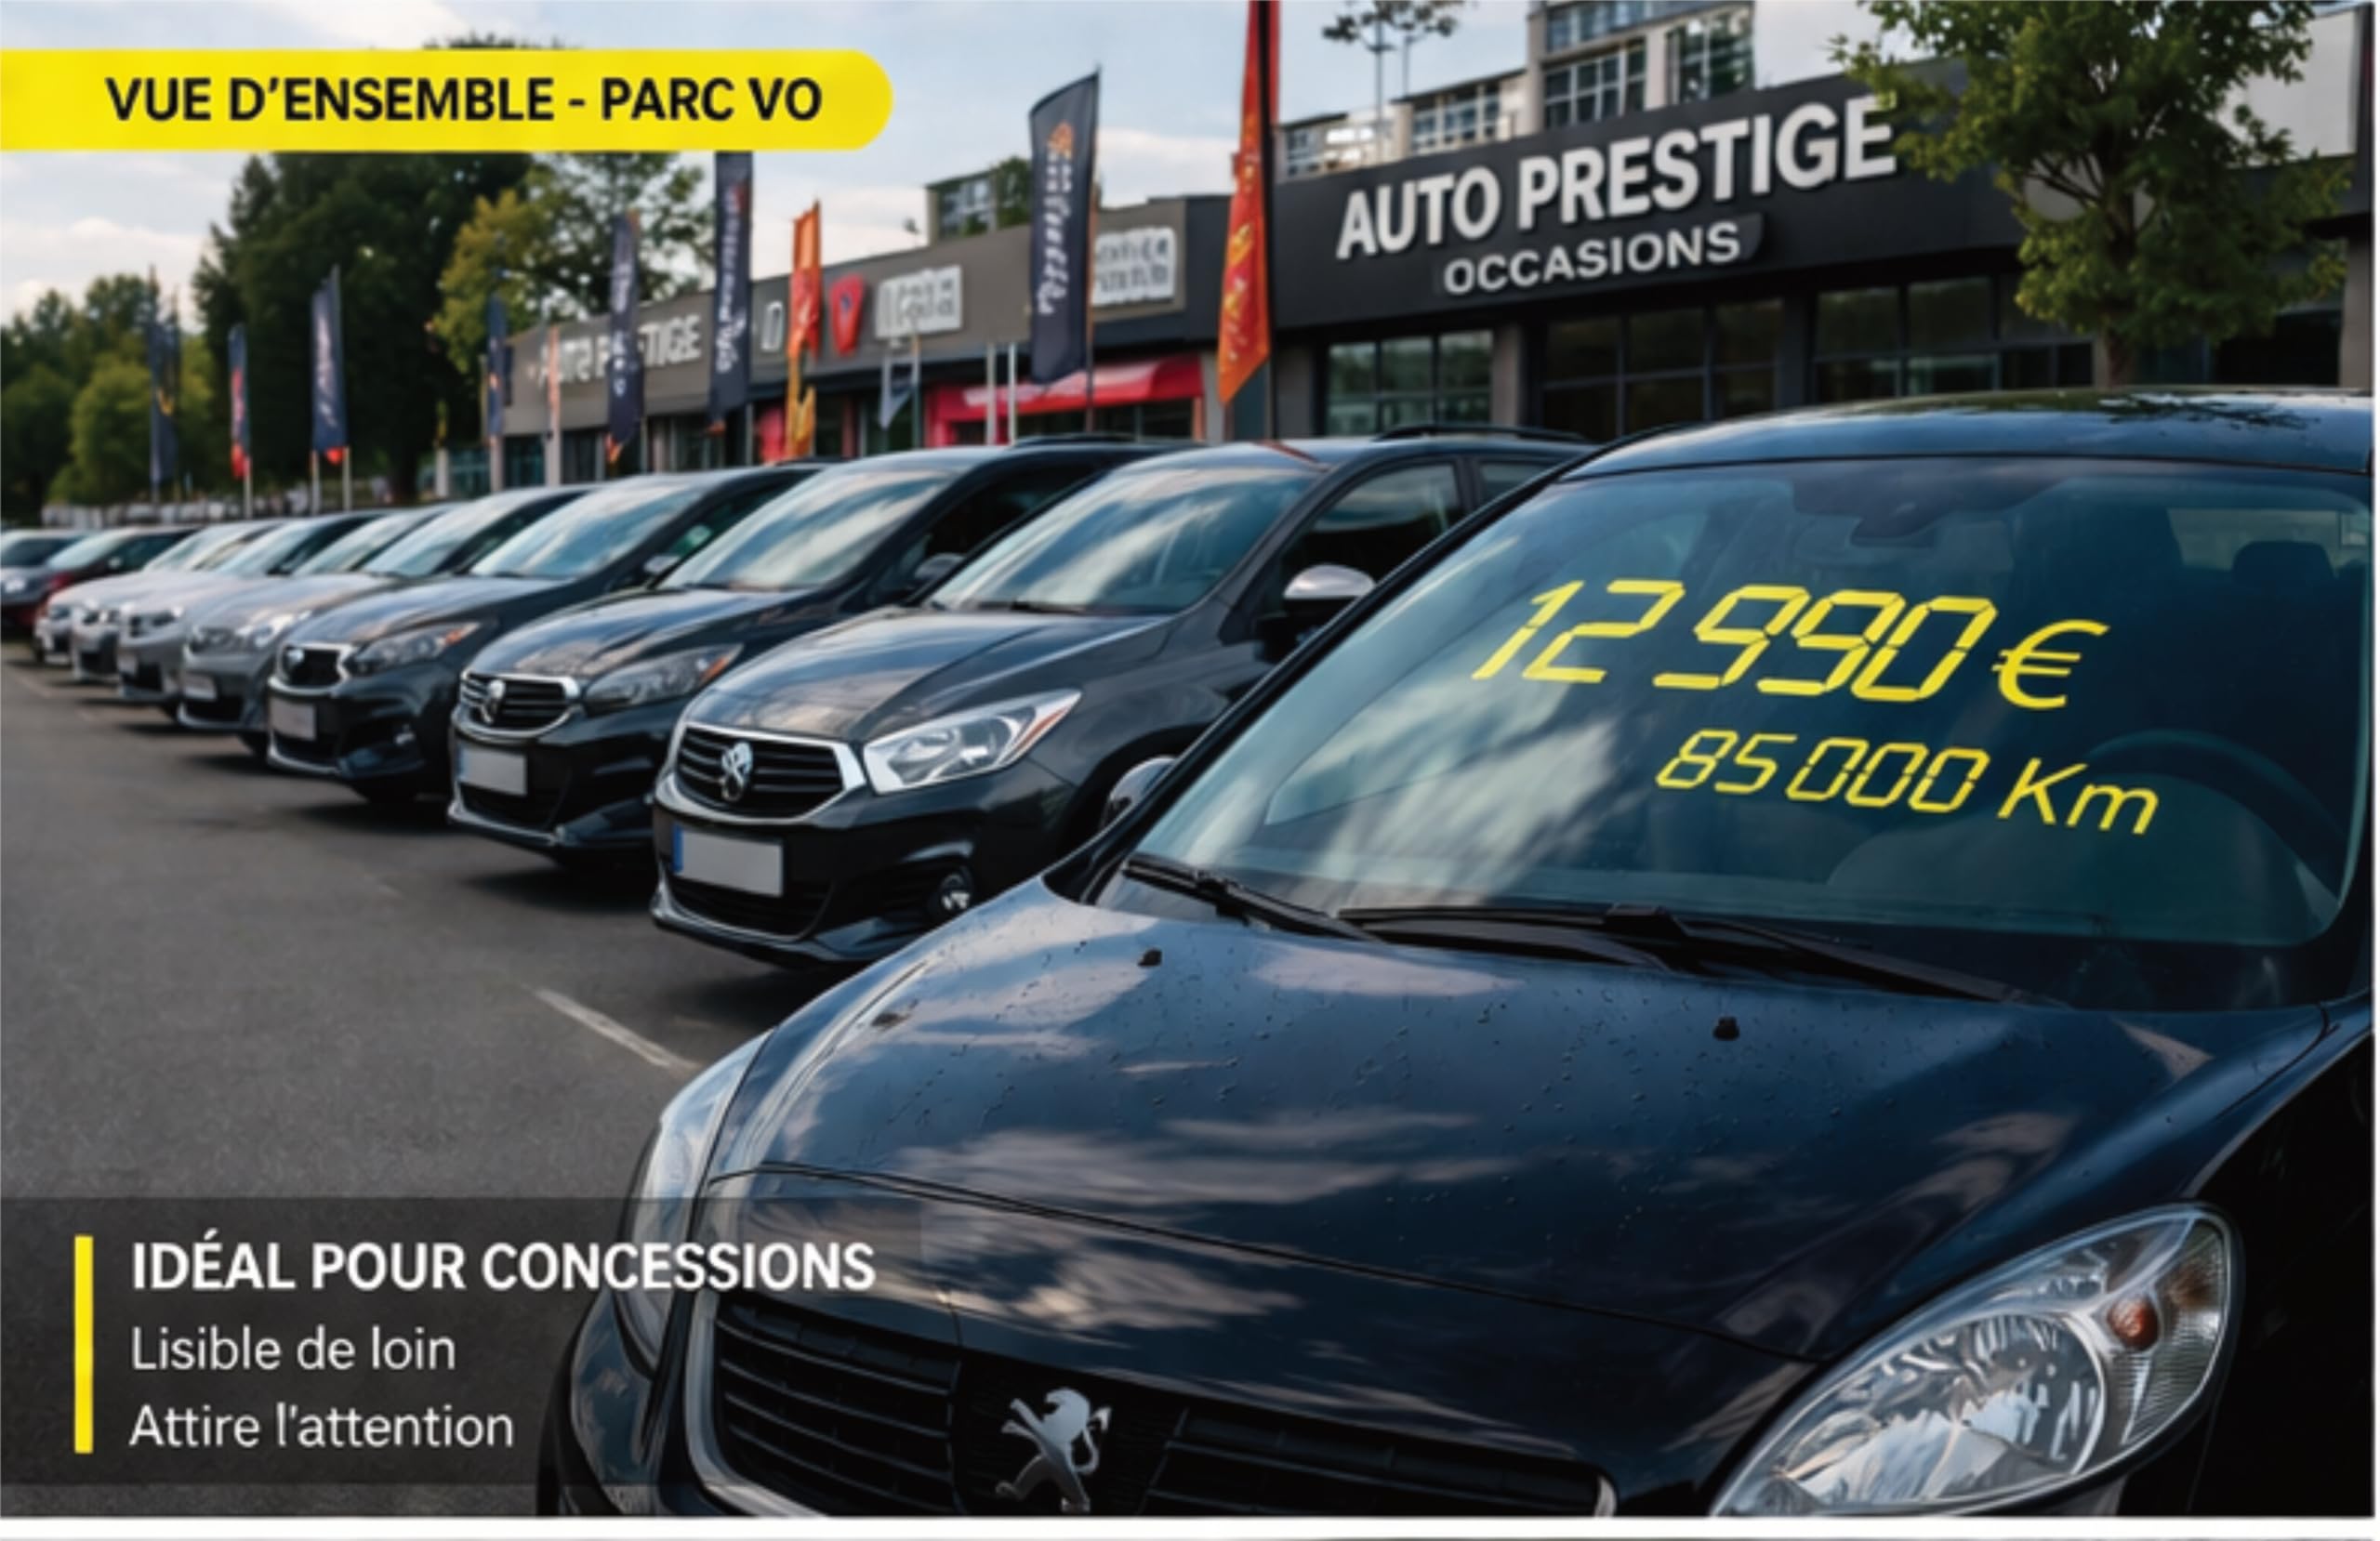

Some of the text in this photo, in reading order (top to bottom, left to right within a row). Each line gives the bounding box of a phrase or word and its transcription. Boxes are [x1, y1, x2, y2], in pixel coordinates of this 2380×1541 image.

[1335, 165, 1502, 261] AUTO
[1517, 92, 1899, 230] PRESTIGE
[1443, 220, 1741, 296] OCCASIONS
[1992, 618, 2109, 710] €
[1997, 757, 2160, 835] Km
